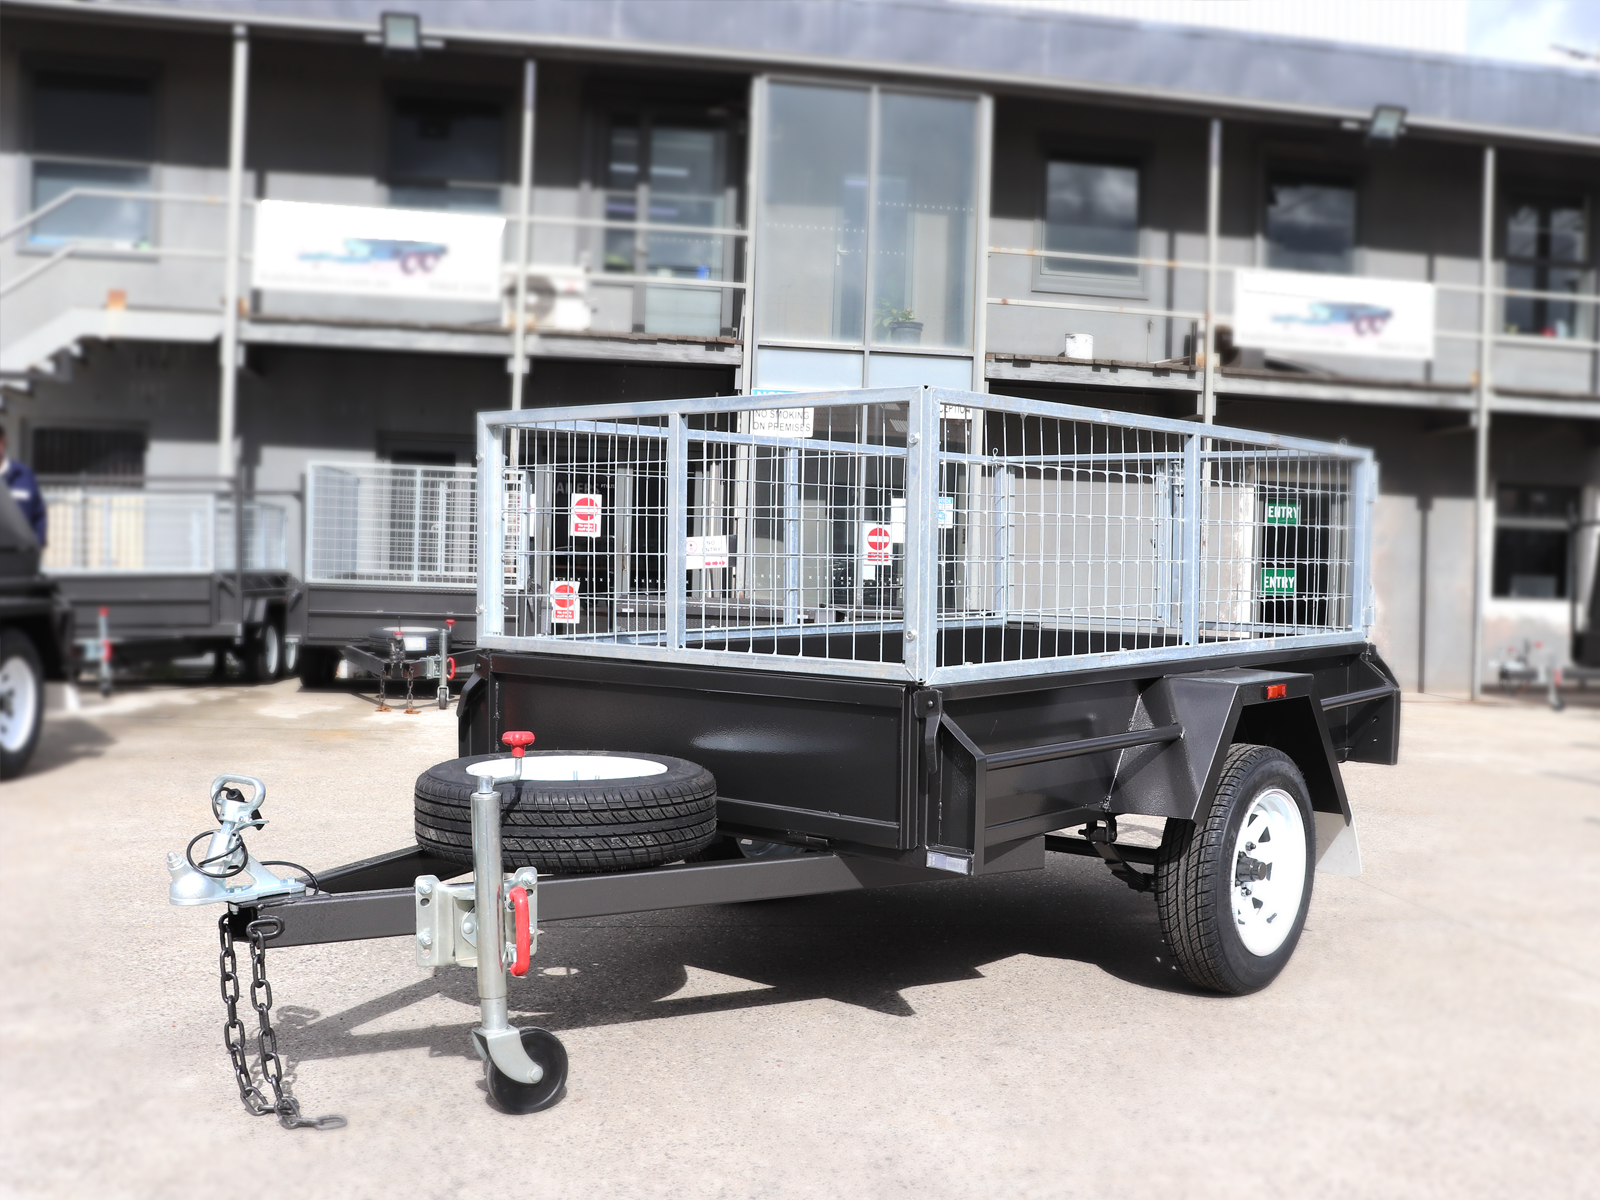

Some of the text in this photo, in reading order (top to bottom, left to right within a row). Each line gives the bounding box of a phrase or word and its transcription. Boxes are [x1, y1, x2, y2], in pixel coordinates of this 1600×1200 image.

[755, 409, 810, 420] NO SMOKING
[753, 421, 811, 432] ON PREMISES
[1268, 505, 1300, 519] ENTRY
[1264, 576, 1295, 589] ENTRY
